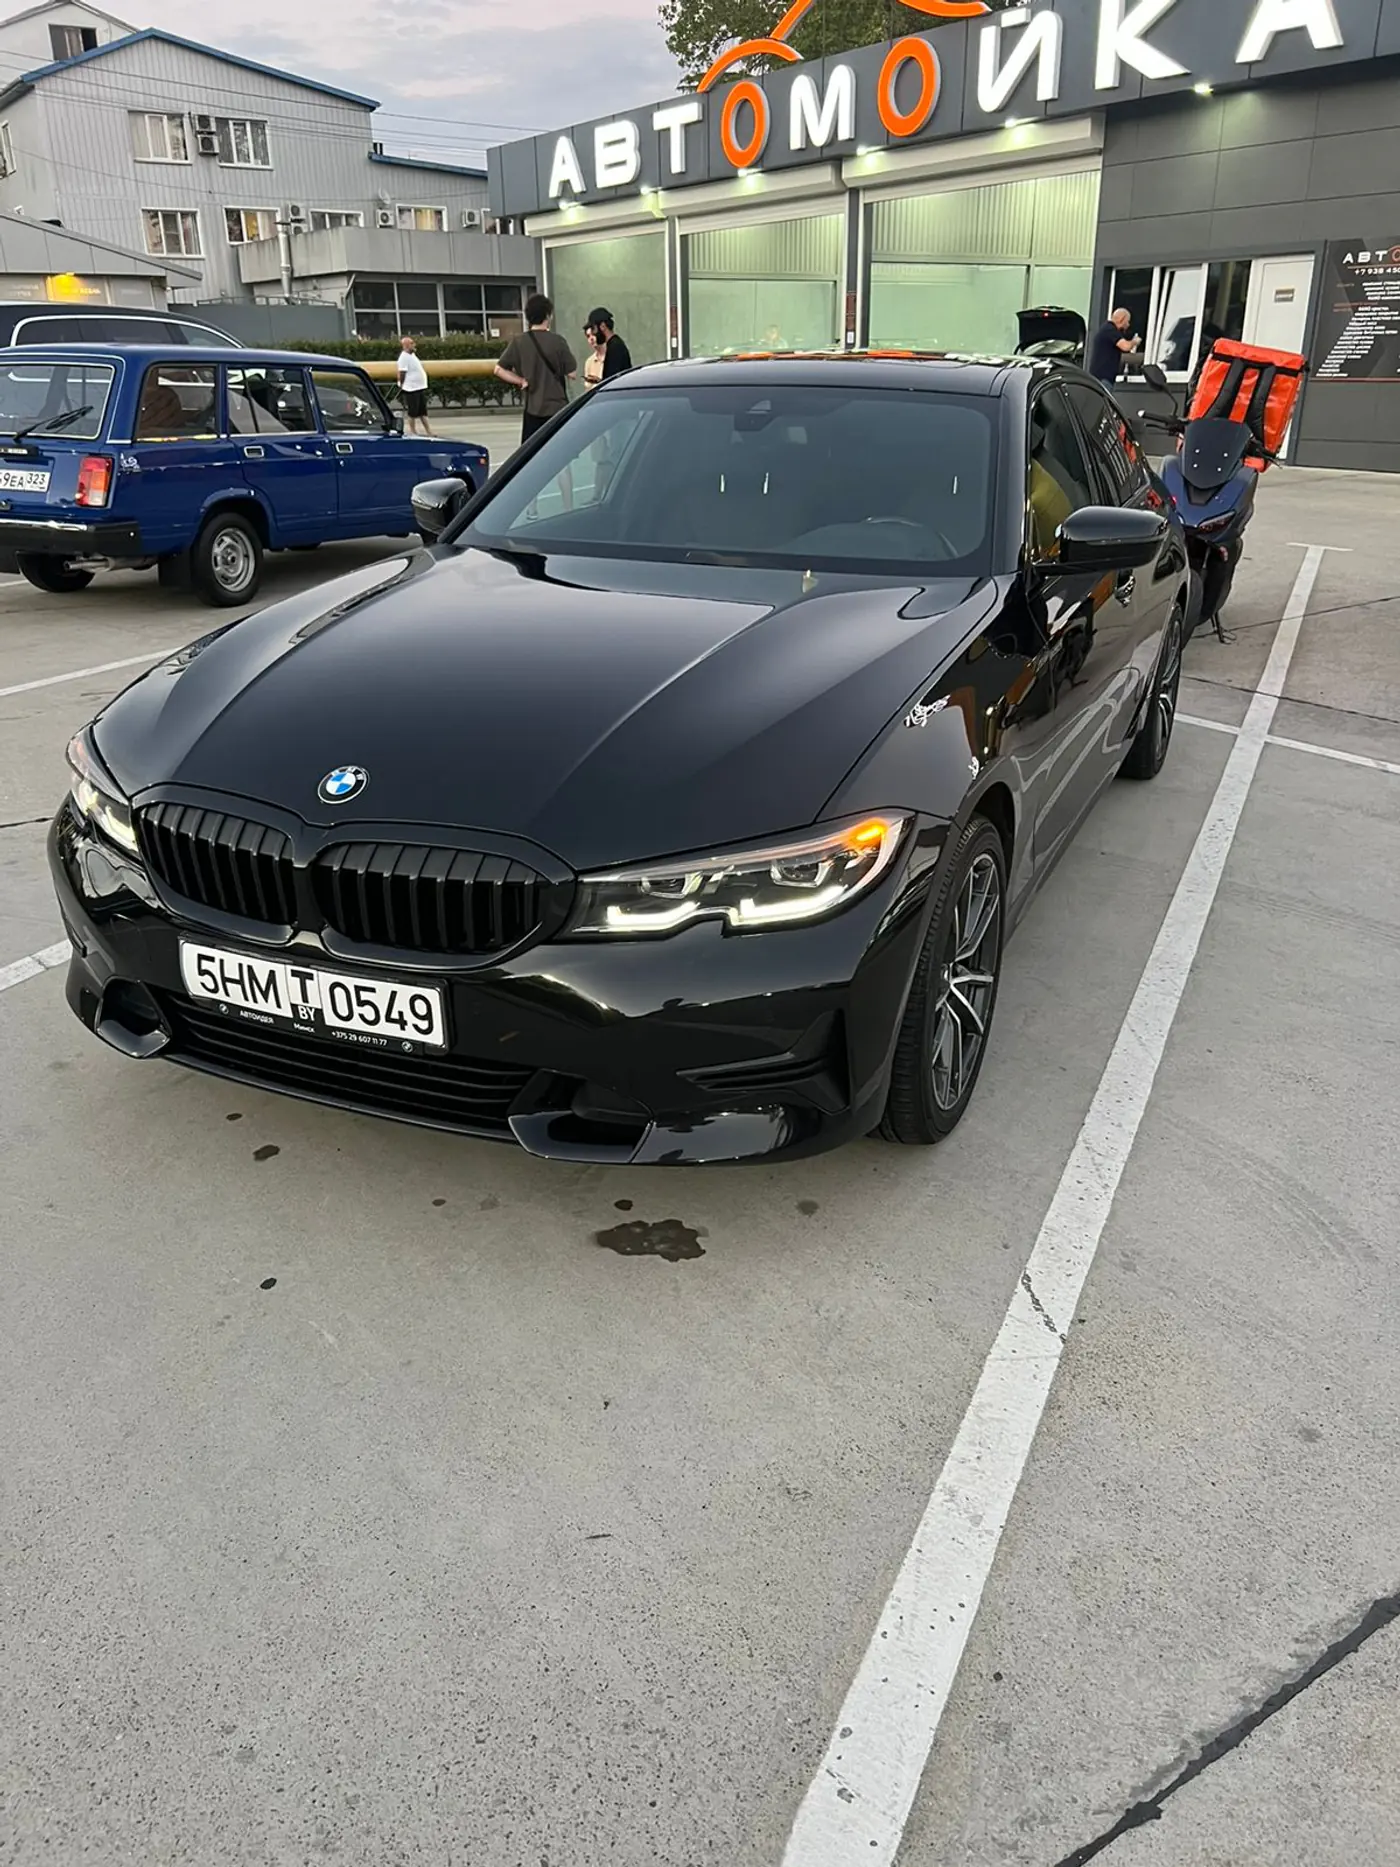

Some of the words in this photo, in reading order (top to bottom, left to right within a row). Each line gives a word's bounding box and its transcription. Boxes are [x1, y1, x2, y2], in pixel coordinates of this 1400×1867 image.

[548, 0, 1345, 199] АВТОМОЙКА
[26, 472, 46, 485] 323
[197, 953, 282, 1009] 5HM
[291, 969, 314, 1004] T
[329, 981, 434, 1036] 0549
[298, 1006, 315, 1022] BY
[348, 1033, 357, 1041] 29
[358, 1035, 371, 1043] 607
[379, 1038, 388, 1046] 77
